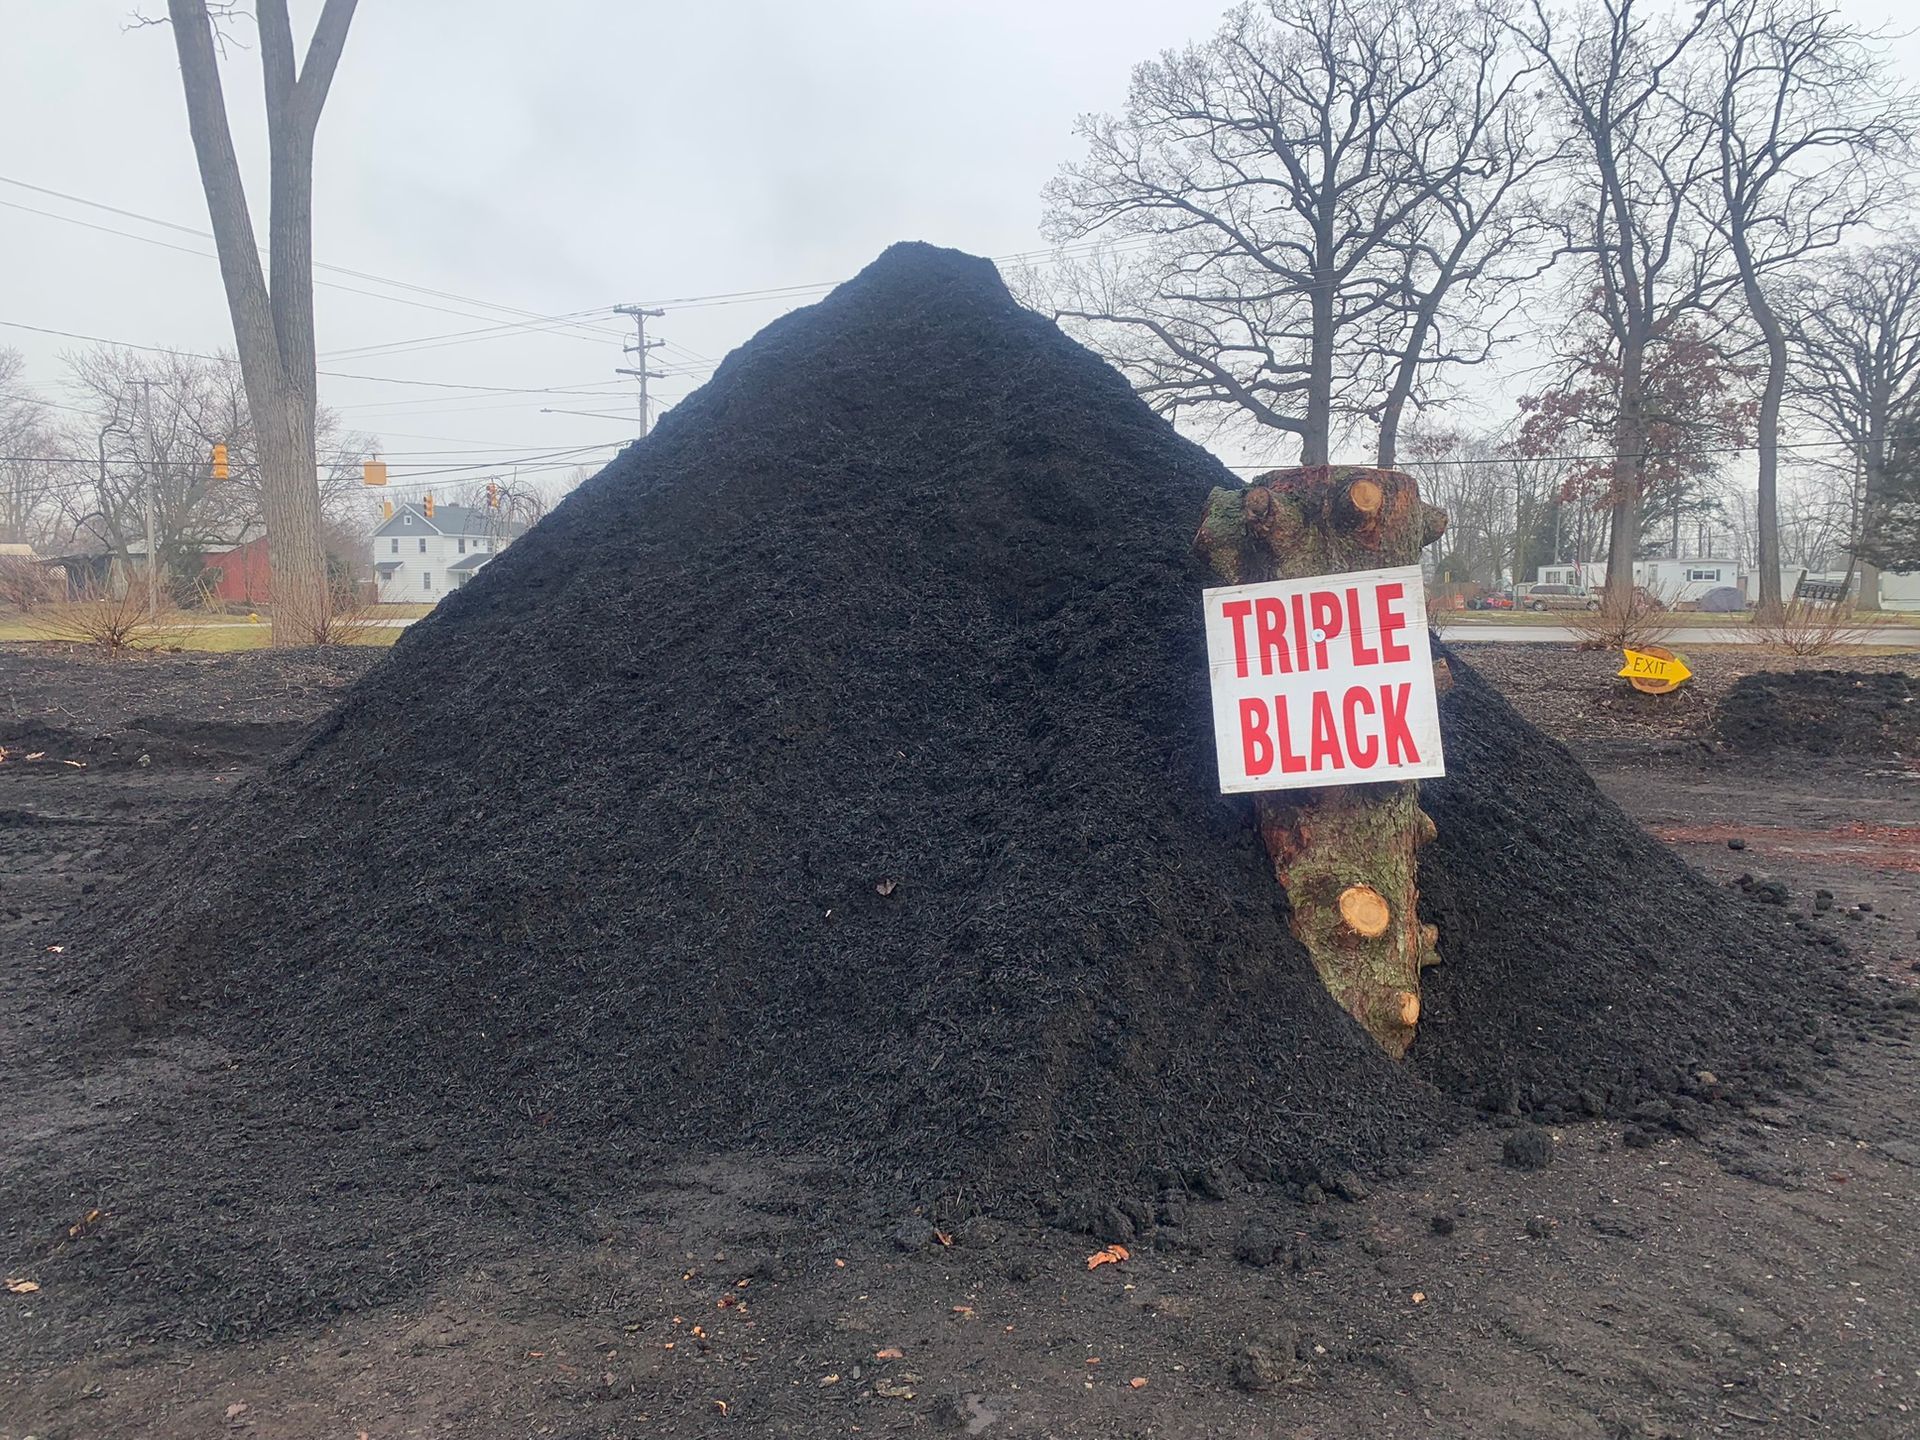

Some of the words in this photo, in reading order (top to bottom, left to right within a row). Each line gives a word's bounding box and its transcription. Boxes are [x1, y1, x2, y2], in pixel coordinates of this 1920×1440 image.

[1222, 583, 1411, 678] TRIPLE
[1633, 656, 1667, 675] EXIT
[1238, 682, 1421, 777] BLACK
